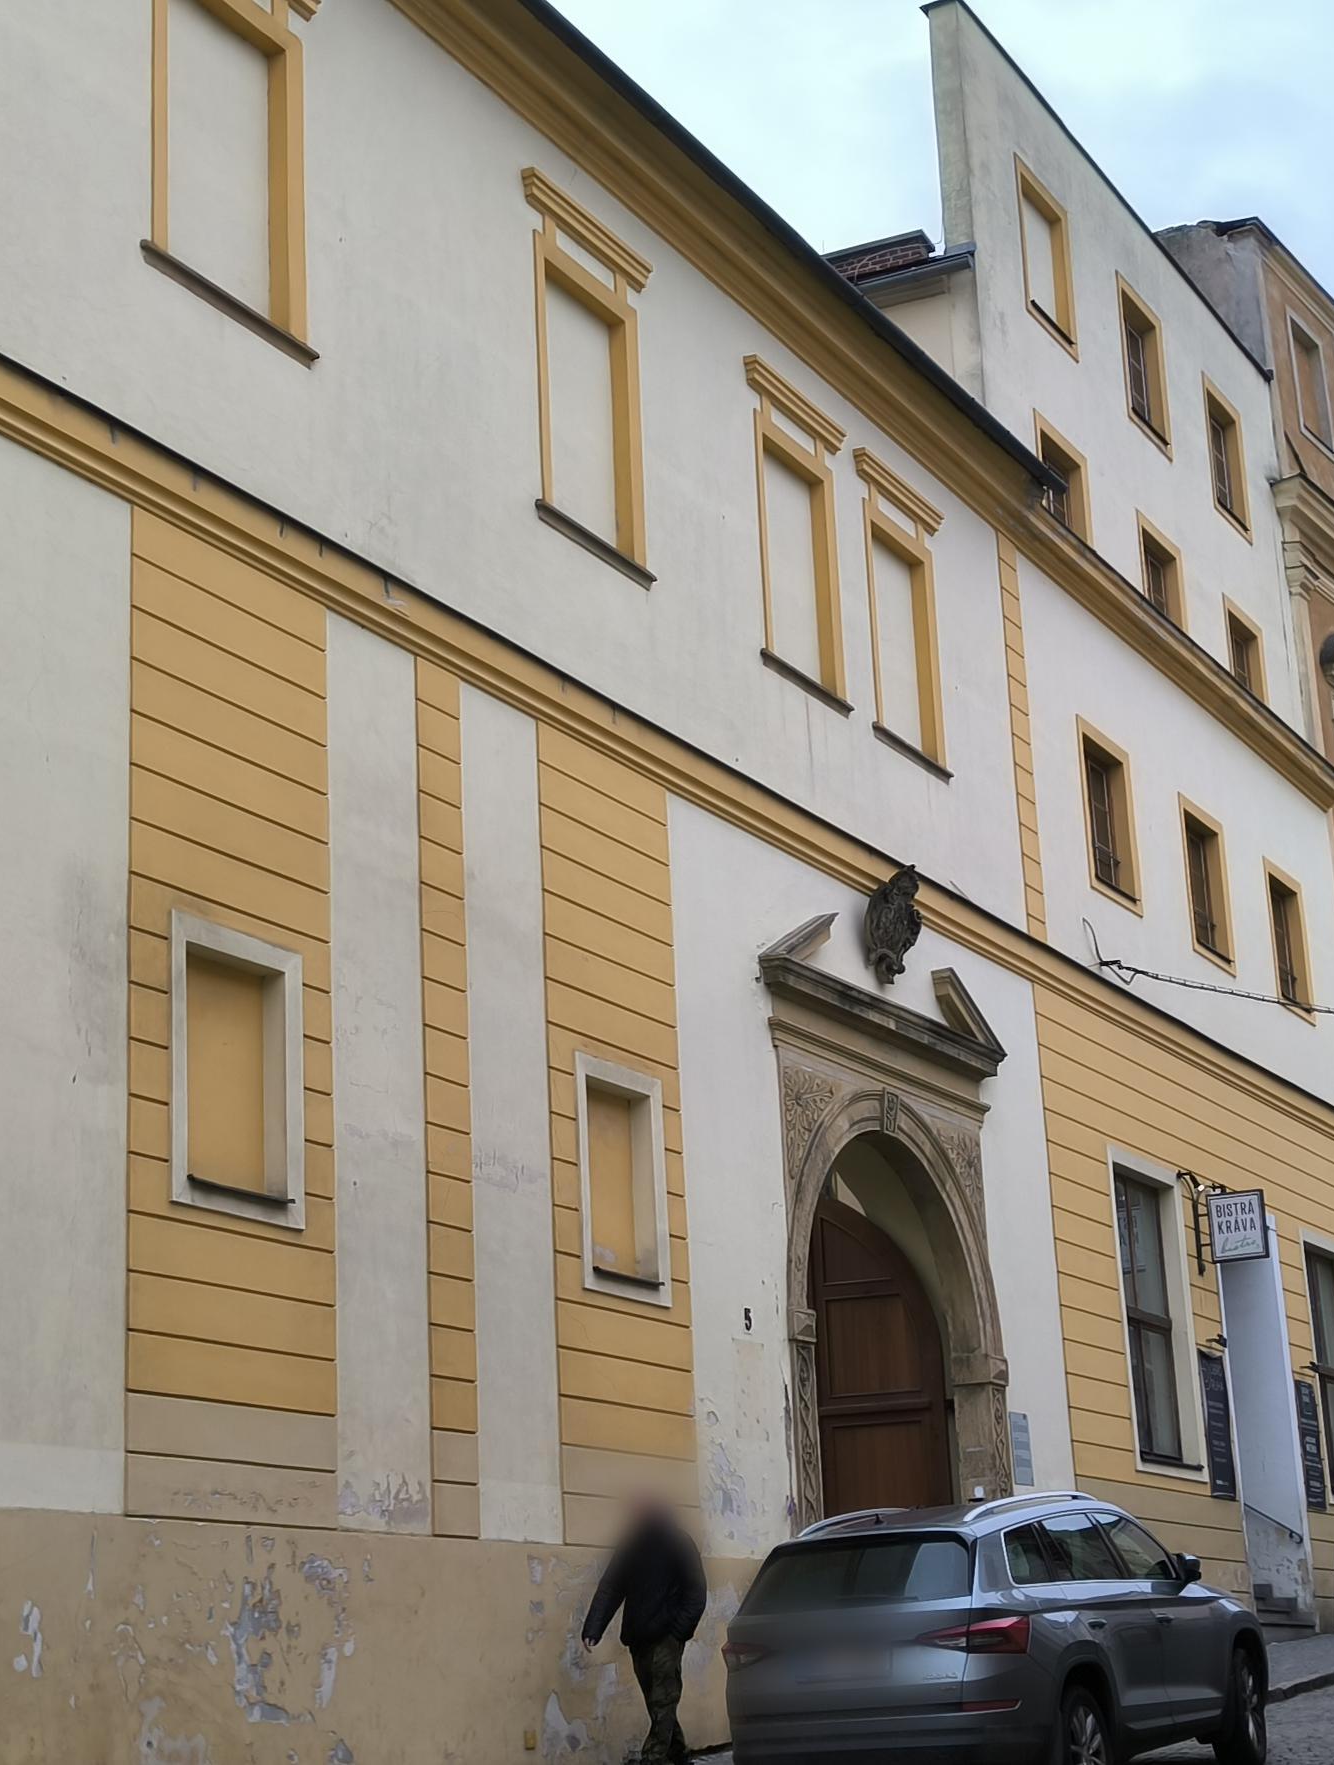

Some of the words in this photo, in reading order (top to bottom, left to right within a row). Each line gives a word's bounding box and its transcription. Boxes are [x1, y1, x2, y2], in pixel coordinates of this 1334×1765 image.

[1215, 1199, 1255, 1218] BISTRÁ
[1217, 1216, 1257, 1235] KRÁVA
[744, 1307, 752, 1332] 5
